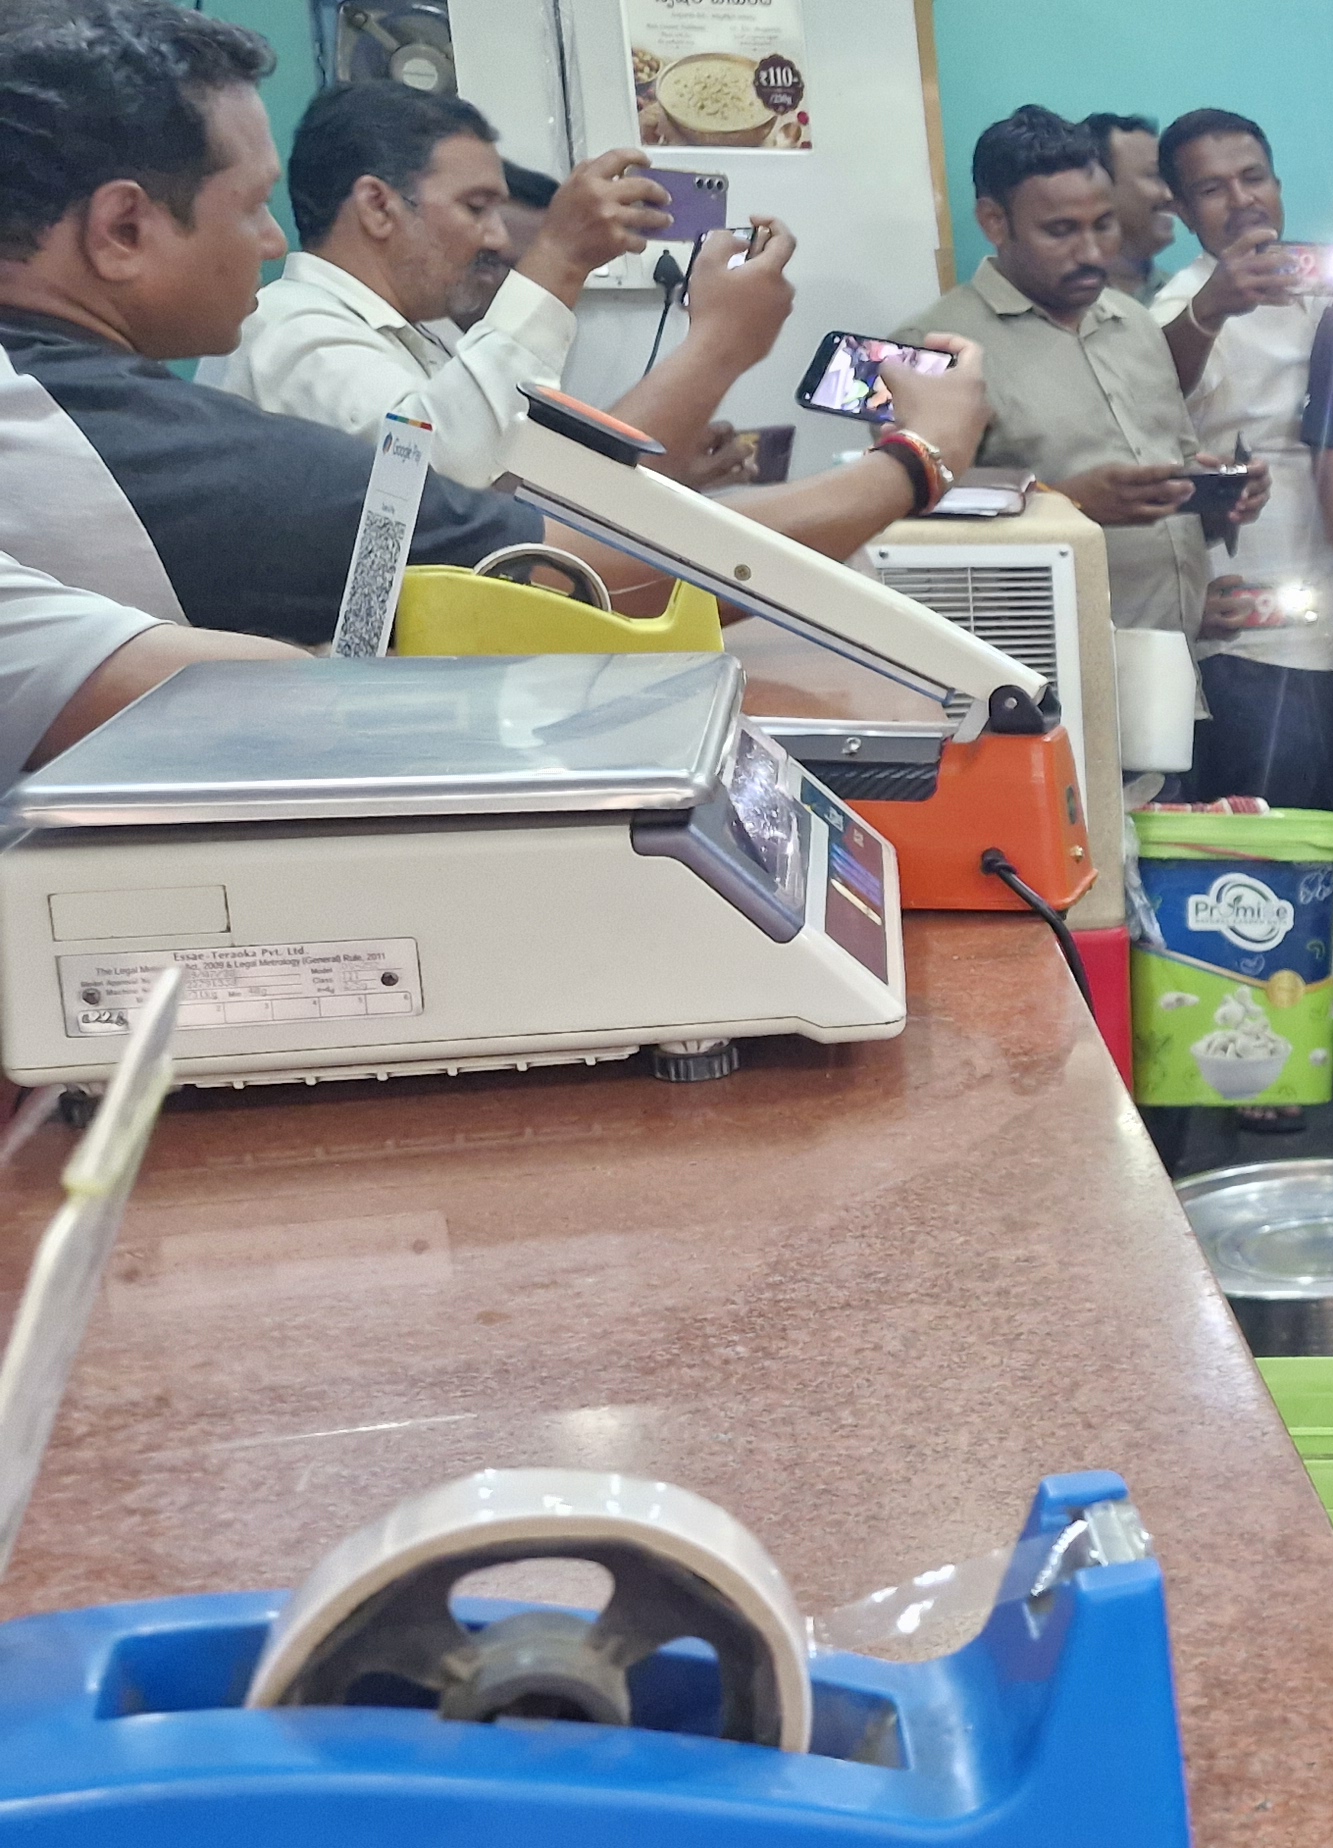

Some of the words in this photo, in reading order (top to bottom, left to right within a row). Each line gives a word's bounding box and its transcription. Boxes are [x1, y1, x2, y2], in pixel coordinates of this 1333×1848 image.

[1194, 899, 1288, 919] Promie
[234, 959, 258, 970] Legal
[366, 951, 386, 960] 2011
